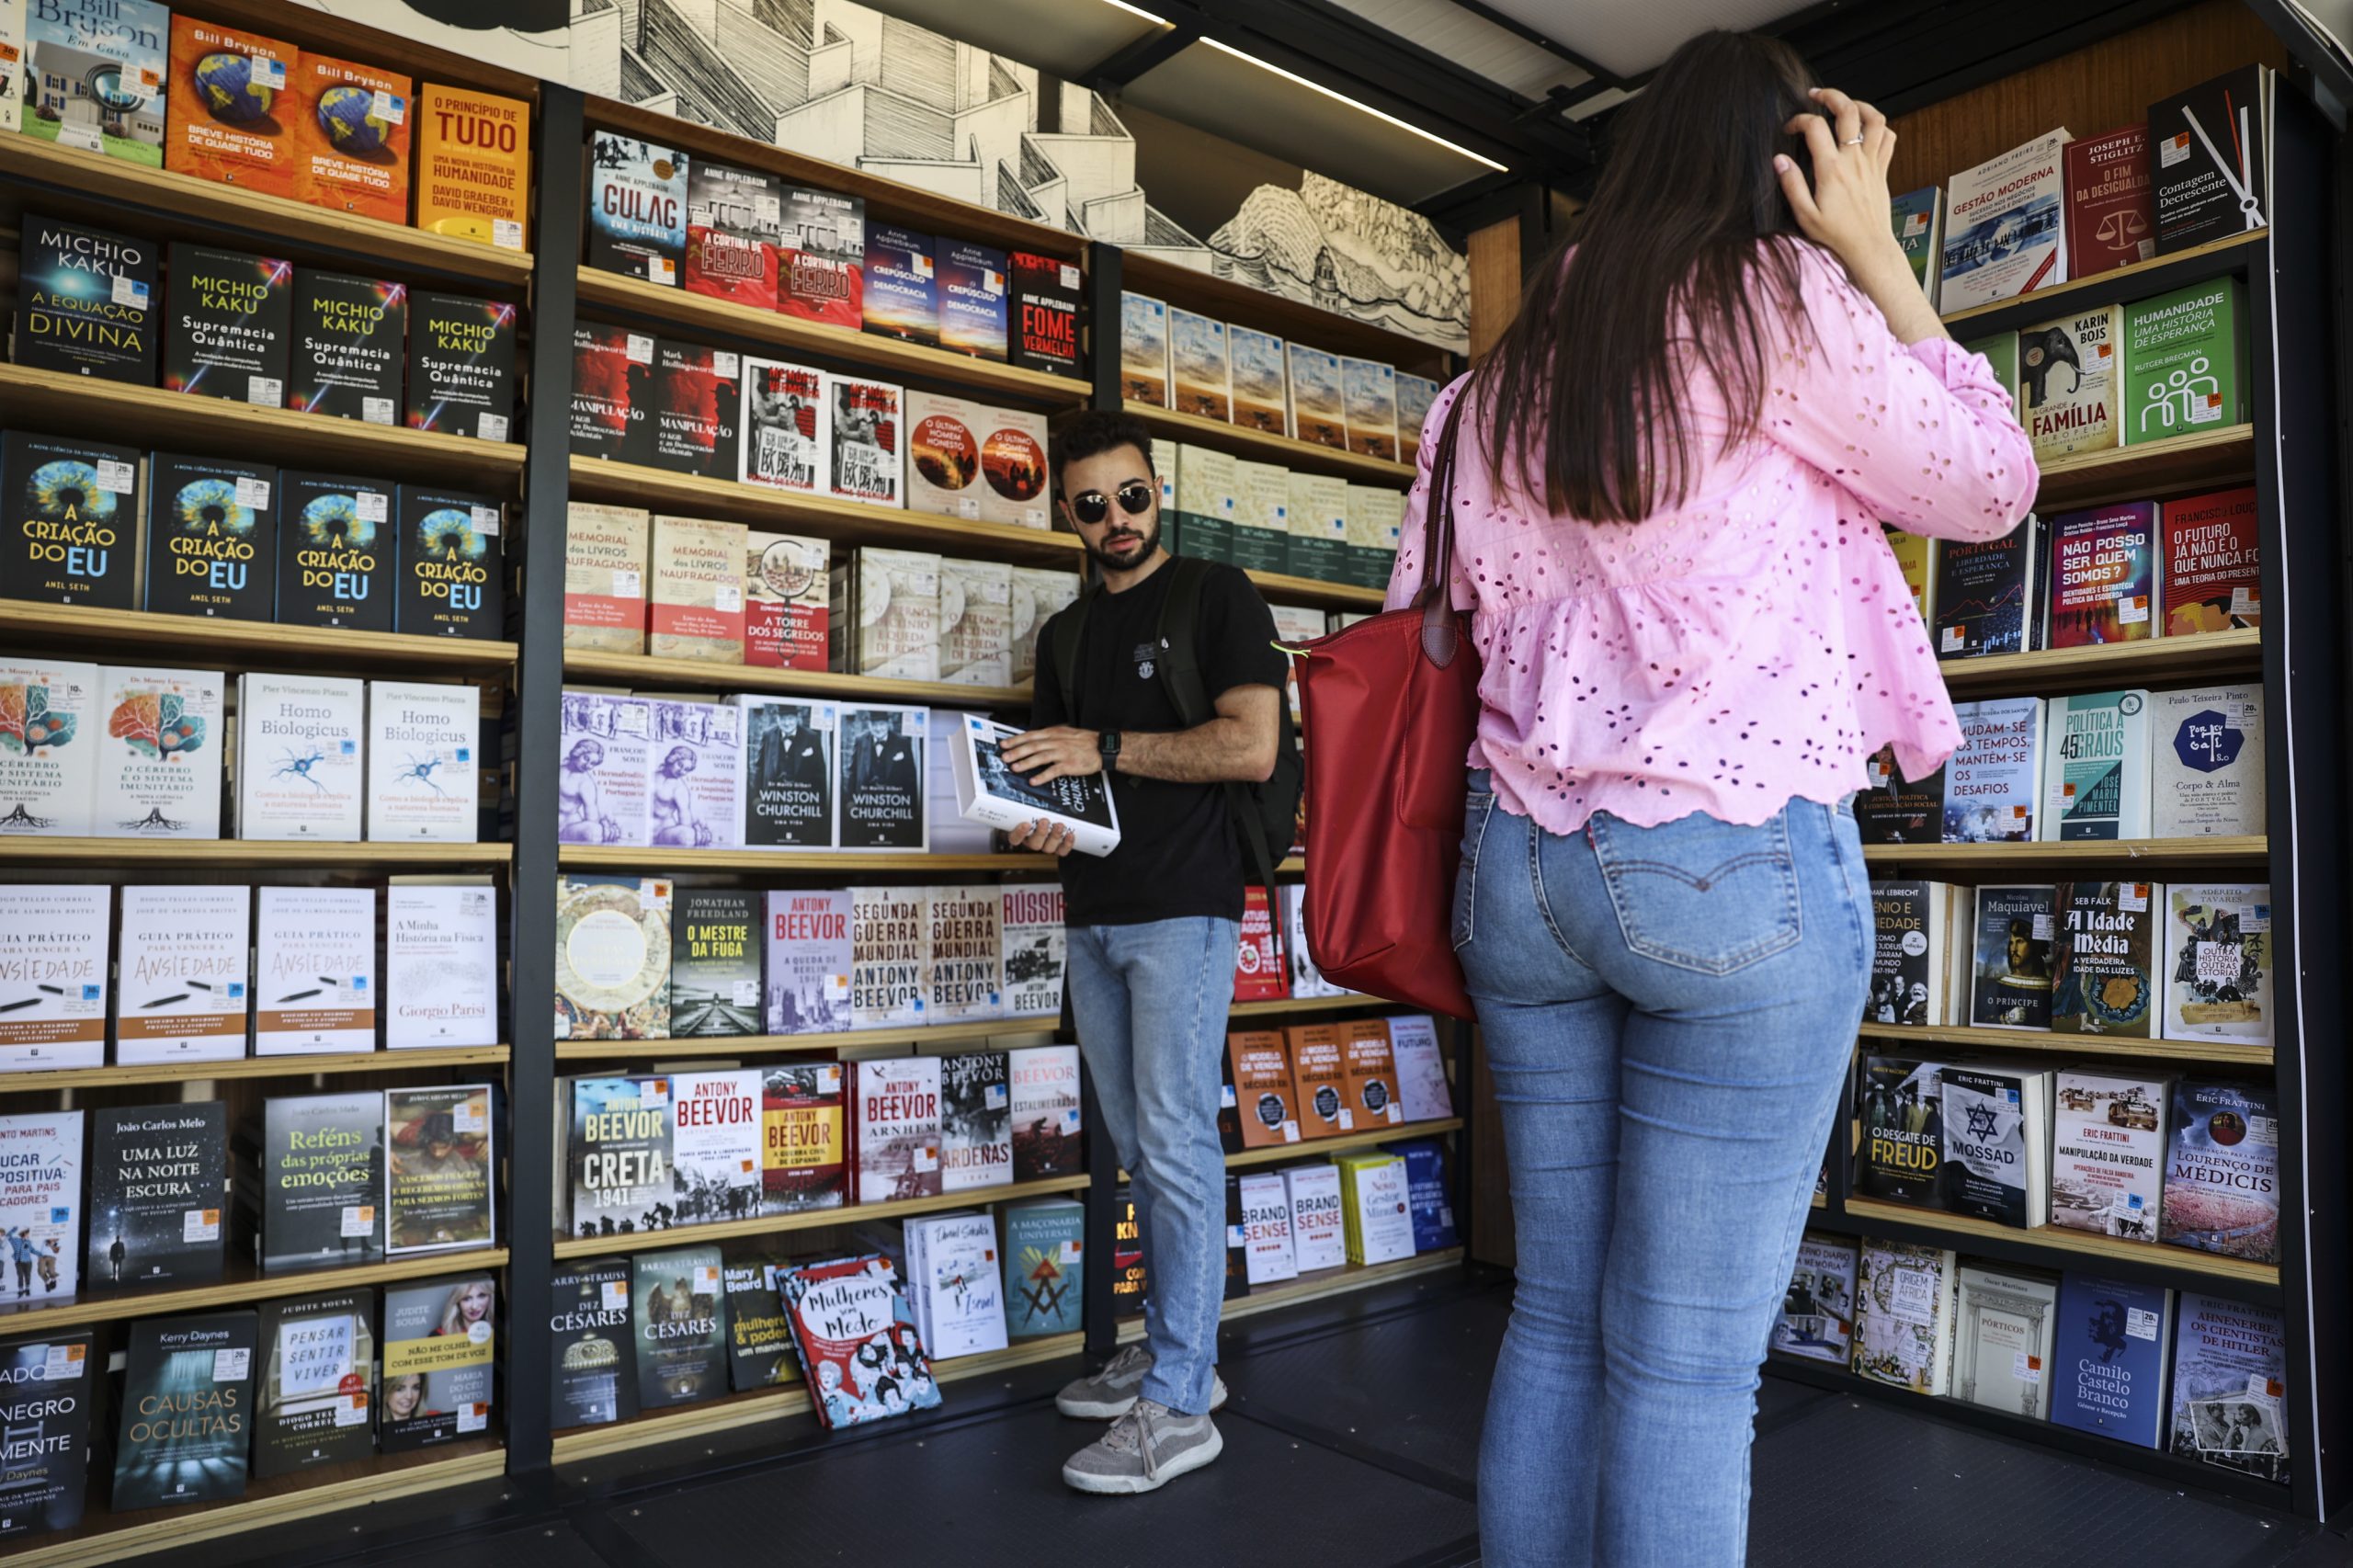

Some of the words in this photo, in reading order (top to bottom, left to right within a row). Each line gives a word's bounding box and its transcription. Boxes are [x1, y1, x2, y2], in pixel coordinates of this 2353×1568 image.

[36, 0, 160, 51] Bryson
[195, 28, 220, 45] Bill
[223, 38, 276, 58] Bryson
[435, 97, 442, 108] O
[446, 98, 500, 118] PRINCÍPIO
[504, 109, 517, 122] DE
[188, 124, 223, 139] BREVE
[225, 131, 274, 150] HISTÓRIA
[436, 111, 517, 153] TUDO
[188, 134, 204, 144] DE
[244, 148, 273, 160] TUDO
[2089, 140, 2131, 155] JOSEPH
[2090, 144, 2143, 164] STIGLITZ
[434, 164, 515, 190] HUMANIDADE
[2160, 170, 2215, 198] Contagem
[433, 185, 460, 199] DAVID
[463, 189, 508, 207] GRAEBER
[1954, 191, 1995, 215] GESTÃO
[1998, 165, 2054, 197] MODERNA
[2160, 178, 2226, 209] Decrescente
[432, 196, 460, 210] DAVID
[463, 201, 515, 219] WENGROW
[603, 184, 677, 230] GULAG
[40, 230, 142, 265] MICHIO
[58, 252, 125, 278] KAKU
[701, 244, 765, 278] FERRO
[192, 275, 268, 300] MICHIO
[31, 292, 45, 304] A
[51, 294, 143, 324] EQUAÇÃO
[202, 293, 257, 314] KAKU
[2134, 292, 2223, 326] HUMANIDADE
[30, 313, 142, 352] DIVINA
[183, 314, 276, 340] Supremacia
[1022, 305, 1075, 342] FOME
[2075, 312, 2109, 333] KARIN
[2134, 324, 2159, 338] UMA
[2162, 309, 2213, 333] HISTÓRIA
[192, 331, 266, 353] Quântica
[2080, 327, 2106, 345] BOJS
[2134, 337, 2148, 349] DE
[2151, 318, 2215, 345] ESPERANÇA
[1022, 335, 1075, 358] VERMELHA
[2134, 358, 2162, 371] RUTGER
[2165, 348, 2202, 364] BREGMAN
[660, 417, 732, 437] MANIPULAÇÃO
[2033, 401, 2107, 437] FAMÍLIA
[64, 504, 77, 520] A
[22, 520, 116, 546] CRIAÇÃO
[2175, 531, 2182, 544] O
[2185, 523, 2231, 542] FUTURO
[2063, 540, 2091, 556] NÃO
[2096, 534, 2145, 551] POSSO
[2174, 544, 2188, 560] JÁ
[2191, 535, 2215, 555] NÃO
[2218, 536, 2225, 551] É
[2230, 537, 2237, 550] O
[29, 542, 66, 562] DO
[67, 546, 108, 577] EU
[674, 559, 688, 567] dos
[691, 560, 728, 571] LIVROS
[2063, 555, 2090, 571] SER
[2096, 550, 2136, 564] QUEM
[2175, 560, 2198, 574] QUE
[2201, 551, 2242, 570] NUNCA
[45, 581, 66, 590] ANIL
[69, 582, 90, 592] SETH
[765, 617, 772, 625] A
[775, 617, 809, 629] TORRE
[748, 627, 770, 636] DOS
[772, 627, 824, 642] SEGREDOS
[2168, 697, 2189, 705] Paulo
[2191, 694, 2222, 703] Teixeira
[2226, 691, 2248, 700] Pinto
[279, 703, 332, 719] Homo
[2066, 710, 2112, 733] POLÍTICA
[262, 720, 349, 739] Biologicus
[2061, 734, 2078, 759] 45
[2077, 730, 2123, 759] GRAUS
[1956, 752, 2027, 767] MANTÊM-SE
[1955, 770, 1971, 781] OS
[2100, 774, 2120, 789] JOSÉ
[759, 790, 819, 803] WINSTON
[1954, 783, 2009, 796] DESAFIOS
[2092, 788, 2119, 800] MARIA
[756, 803, 822, 817] CHURCHILL
[2078, 801, 2118, 812] PIMENTEL
[791, 898, 832, 912] ANTONY
[854, 904, 917, 919] SEGUNDA
[1987, 901, 2049, 915] Maquiavel
[776, 915, 846, 940] BEEVOR
[854, 922, 918, 941] GUERRA
[2086, 912, 2135, 931] Idade
[139, 933, 171, 941] GUIA
[176, 930, 233, 941] PRÁTICO
[688, 926, 694, 940] O
[700, 926, 747, 941] MESTRE
[692, 942, 709, 957] DA
[712, 941, 743, 957] FUGA
[854, 944, 918, 961] MUNDIAL
[2074, 934, 2129, 955] Média
[854, 966, 918, 985] ANTONY
[695, 1082, 737, 1097] ANTONY
[1958, 1075, 1972, 1084] ERIC
[1974, 1078, 2004, 1087] FRATTINI
[677, 1097, 753, 1127] BEEVOR
[117, 1122, 140, 1133] João
[142, 1120, 176, 1131] Carlos
[179, 1118, 205, 1128] Melo
[585, 1110, 664, 1142] BEEVOR
[290, 1128, 362, 1149] Reféns
[1872, 1127, 1881, 1137] O
[1883, 1129, 1920, 1143] RESGATE
[1923, 1135, 1936, 1146] DE
[122, 1149, 162, 1162] UMA
[167, 1144, 199, 1158] LUZ
[281, 1154, 306, 1168] das
[310, 1150, 369, 1168] próprias
[1872, 1139, 1937, 1170] FREUD
[1953, 1142, 2014, 1165] MOSSAD
[2059, 1146, 2108, 1162] MANIPULAÇÃO
[2109, 1152, 2119, 1162] DA
[2121, 1154, 2153, 1167] VERDADE
[119, 1167, 142, 1180] NA
[148, 1163, 199, 1177] NOITE
[584, 1151, 665, 1189] CRETA
[2177, 1152, 2250, 1174] LOURENÇO
[2255, 1165, 2274, 1176] DE
[281, 1168, 369, 1189] emoções
[2176, 1165, 2272, 1192] MÉDICIS
[126, 1181, 192, 1199] ESCURA
[594, 1188, 630, 1208] 1941
[1297, 1196, 1339, 1213] BRAND
[1298, 1210, 1340, 1230] SENSE
[809, 1285, 888, 1312] Mulheres
[290, 1326, 345, 1344] PENSAR
[644, 1318, 716, 1340] CÉSARES
[826, 1312, 880, 1337] Medo
[290, 1346, 344, 1364] SENTIR
[294, 1364, 339, 1381] VIVER
[2079, 1359, 2131, 1381] Camilo
[2078, 1373, 2131, 1395] Castelo
[140, 1389, 236, 1415] CAUSAS
[2077, 1385, 2128, 1409] Branco
[131, 1414, 241, 1442] OCULTAS
